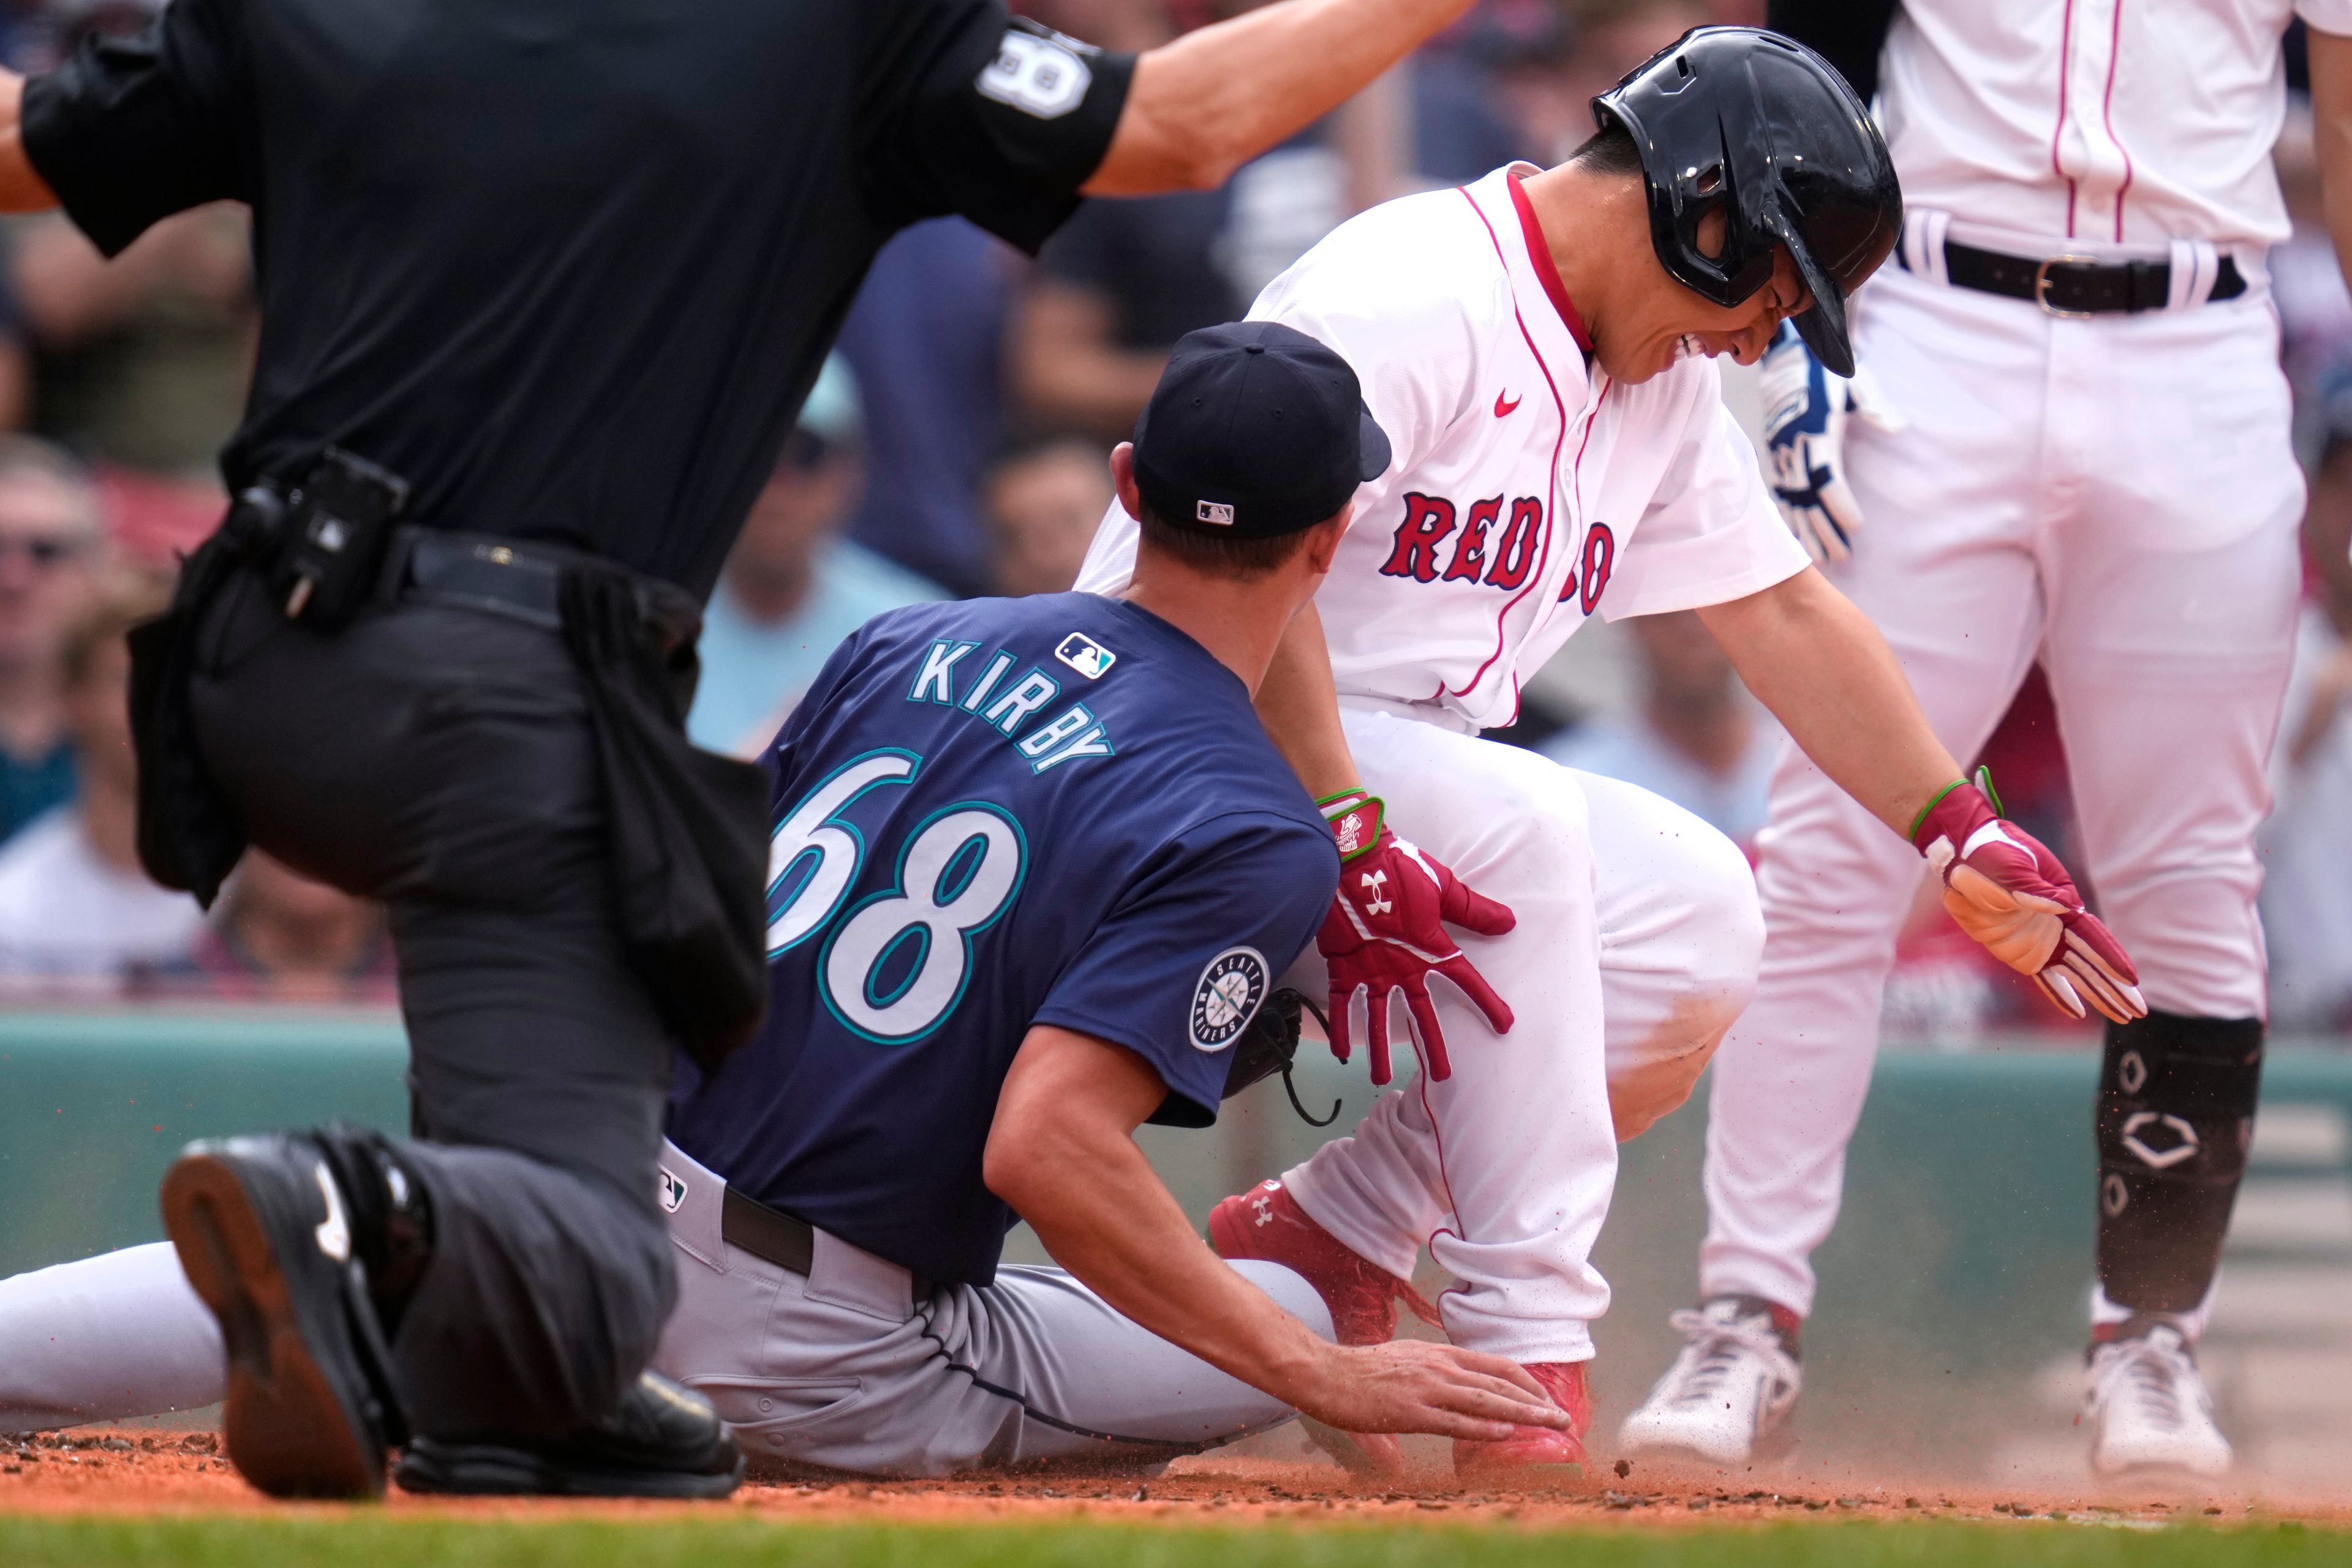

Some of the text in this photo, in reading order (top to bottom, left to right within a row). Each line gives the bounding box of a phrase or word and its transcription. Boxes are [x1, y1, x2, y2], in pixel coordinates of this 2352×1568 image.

[1379, 491, 1544, 591] RED
[907, 639, 1115, 775] KIRBY
[766, 747, 1028, 1046] 68
[1195, 992, 1236, 1041] MARINERS
[1216, 957, 1261, 1005] SEATTLE
